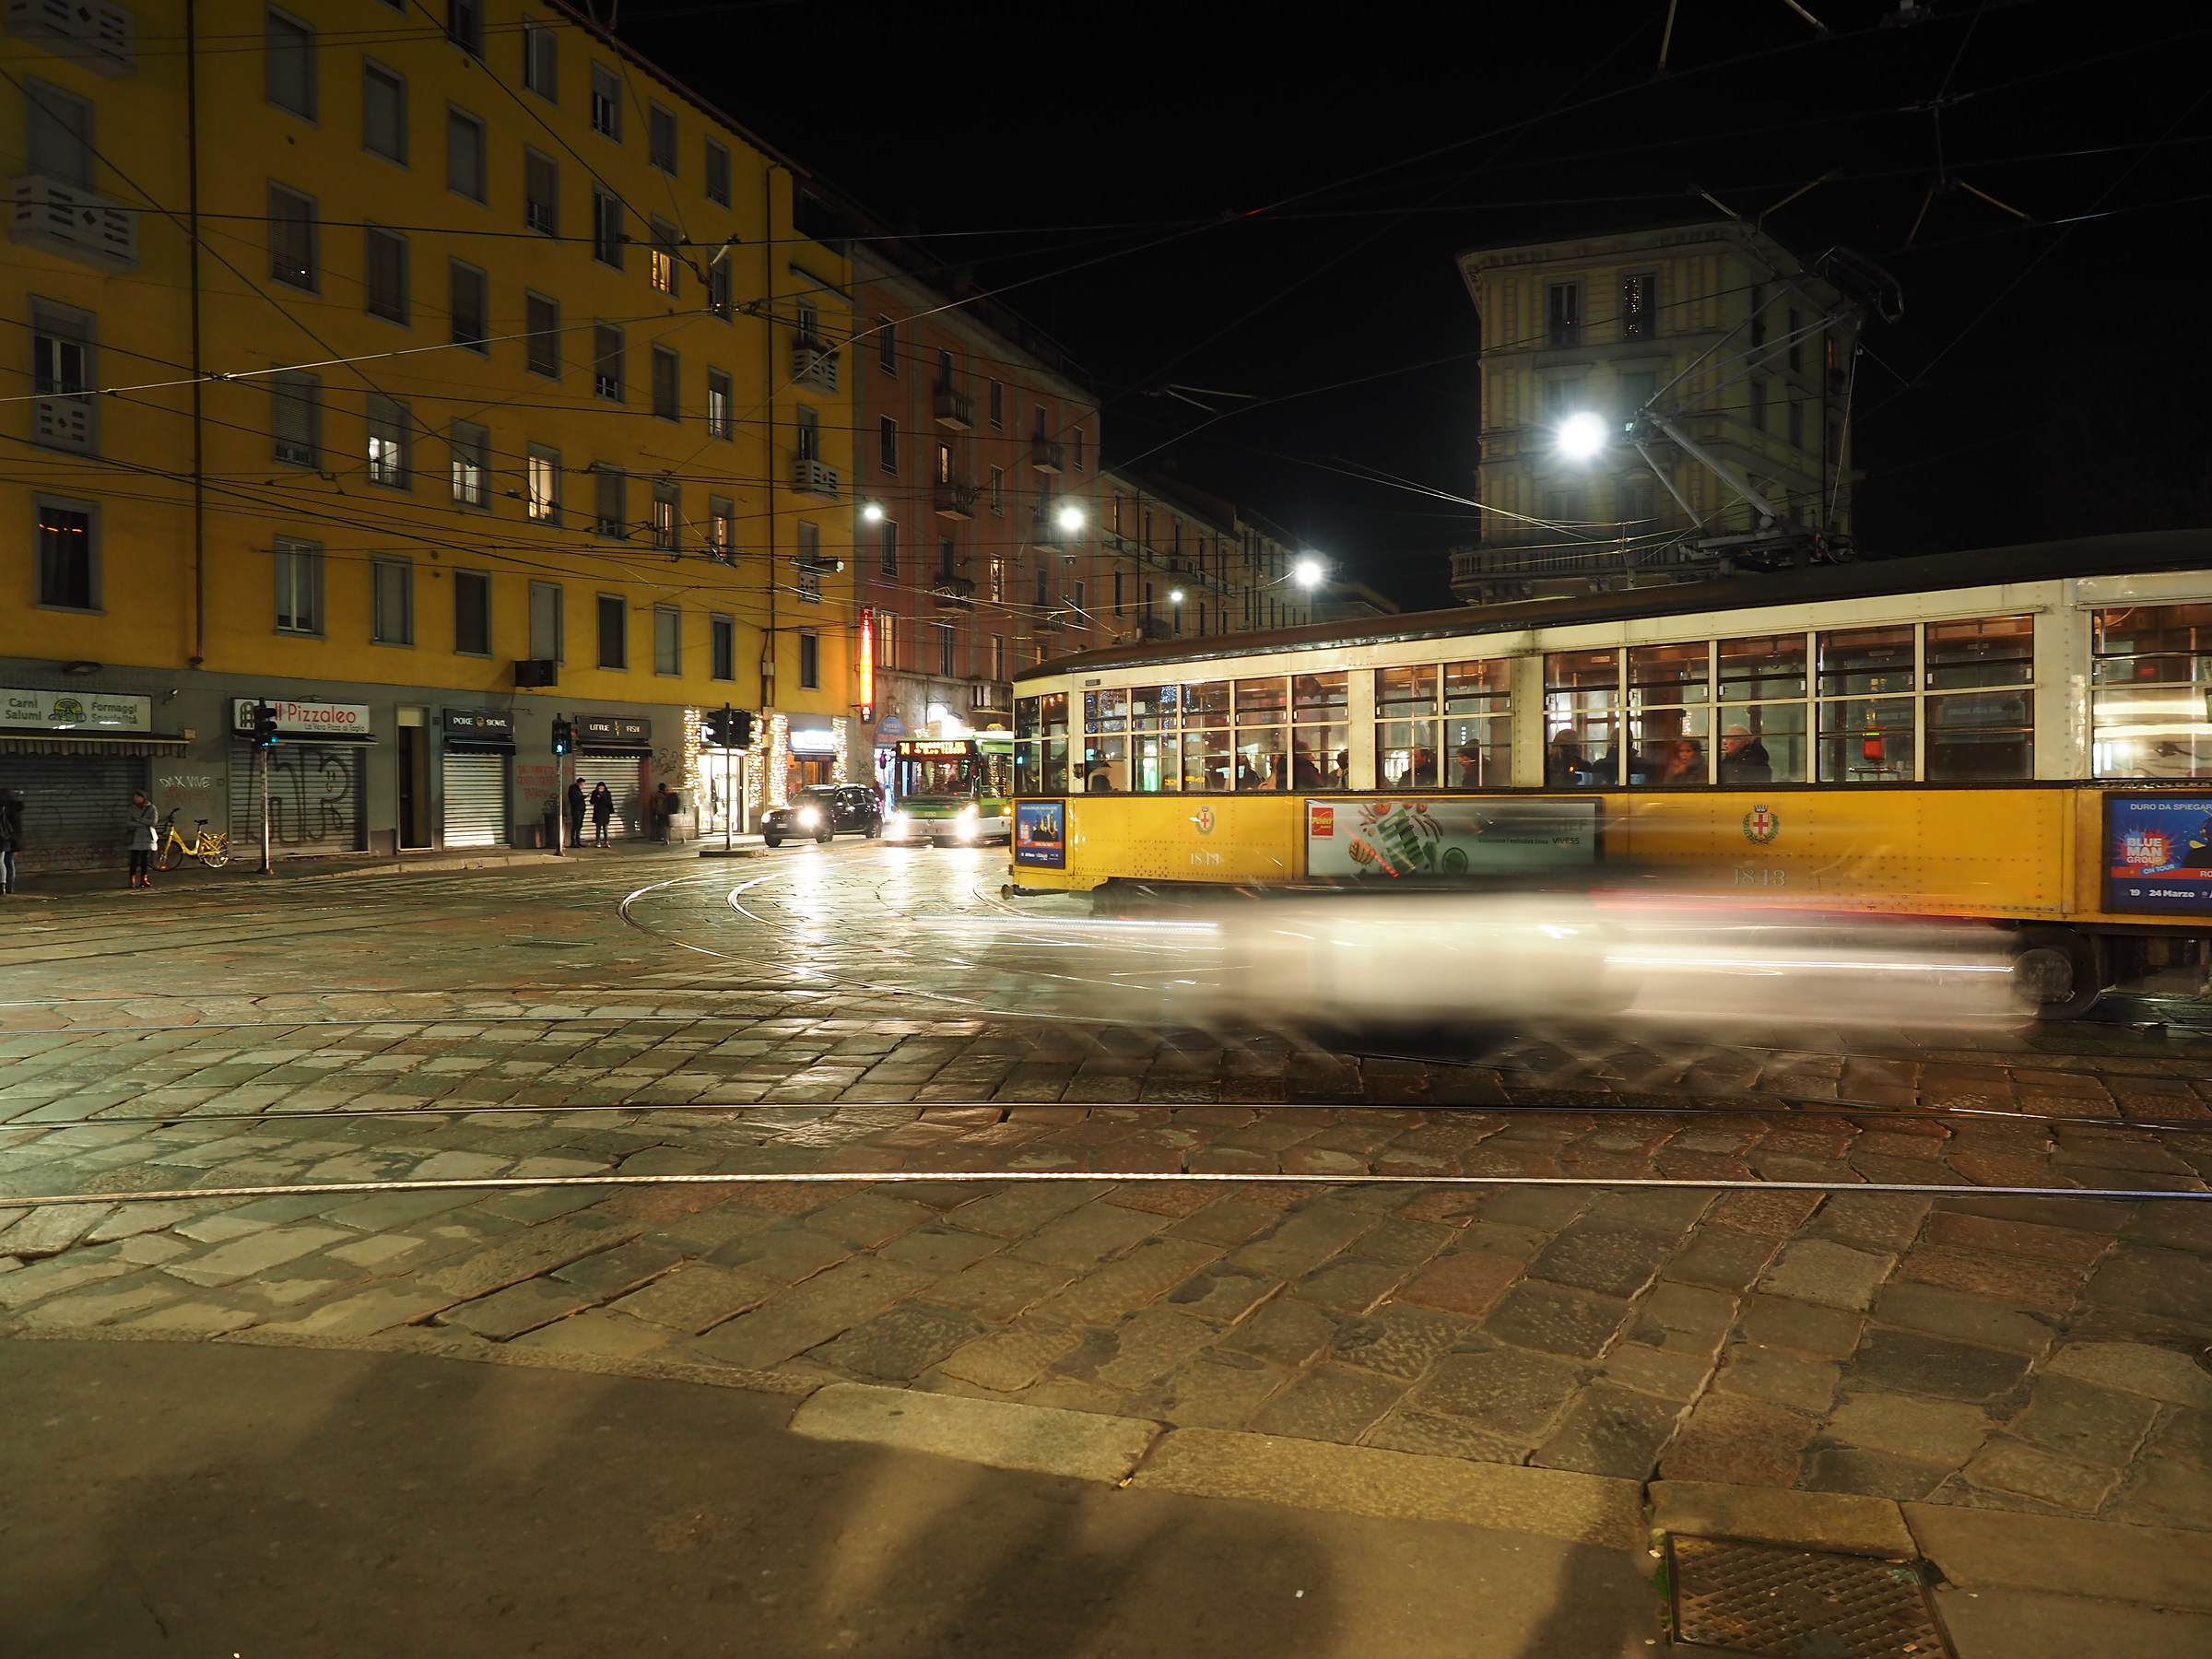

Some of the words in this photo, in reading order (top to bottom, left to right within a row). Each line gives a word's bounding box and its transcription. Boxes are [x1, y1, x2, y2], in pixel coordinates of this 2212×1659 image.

[8, 698, 38, 709] Carni
[91, 702, 137, 714] Formaggi
[6, 710, 41, 721] Salumi
[288, 703, 357, 724] Pizzaleo
[589, 724, 610, 732] LITTLE
[2126, 838, 2163, 847] BLUE
[2126, 847, 2162, 857] MAN
[2157, 864, 2175, 873] TOUR
[1734, 868, 1786, 887] 1843
